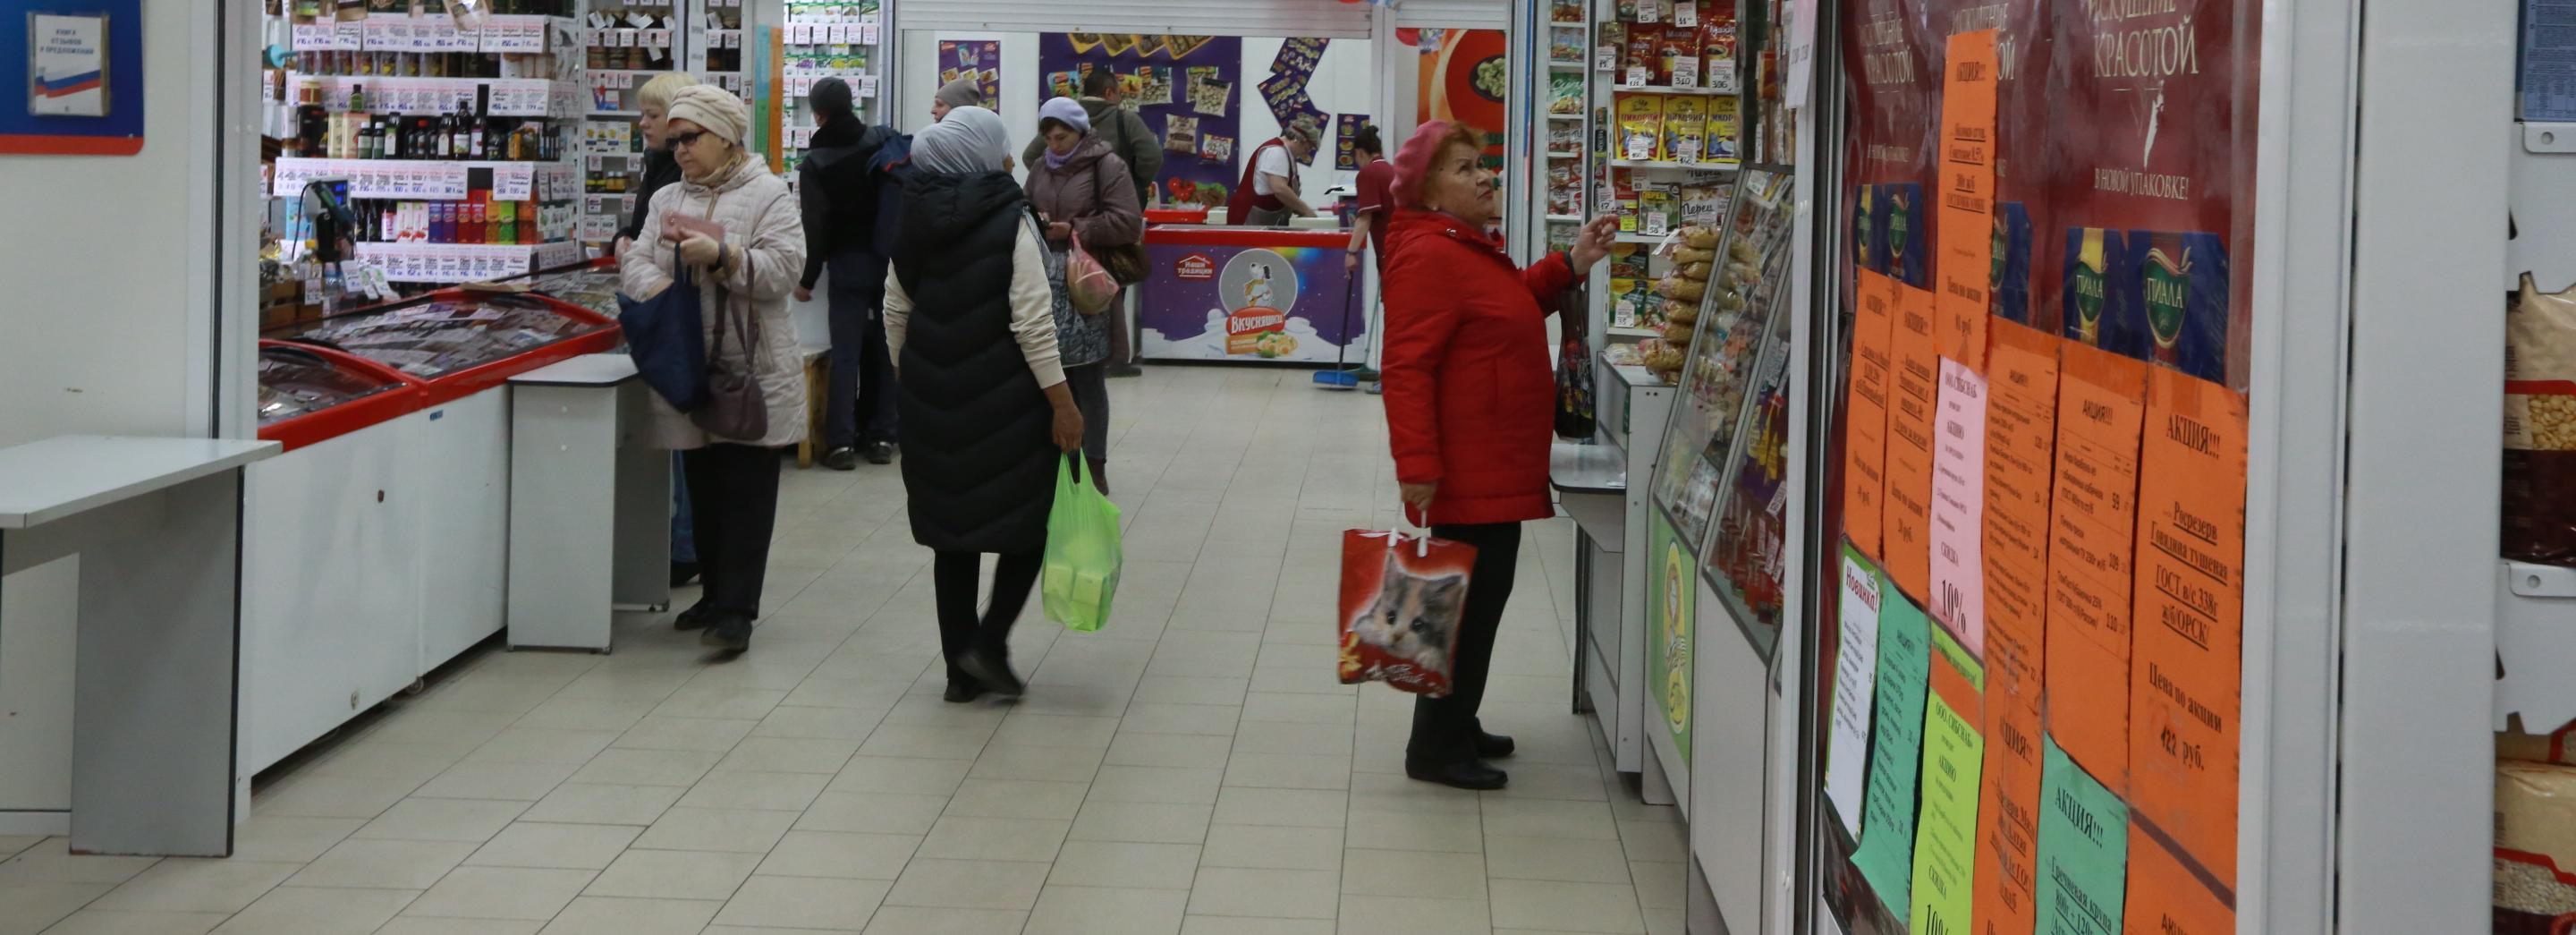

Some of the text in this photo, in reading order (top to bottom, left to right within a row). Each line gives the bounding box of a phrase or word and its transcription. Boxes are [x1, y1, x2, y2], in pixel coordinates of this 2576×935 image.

[2094, 14, 2199, 78] КРАСОТОЙ
[2095, 167, 2190, 200] В НОВОЙ УПАКОВКЕ!
[2076, 274, 2104, 299] ПИАЛА
[2148, 277, 2183, 309] ПИАЛА
[2166, 414, 2220, 460] АКЦИЯ!!!
[2174, 501, 2217, 540] Росрезерв
[2151, 521, 2228, 582] Говядина тушеная
[1845, 565, 1878, 614] Новинка!
[1942, 579, 1966, 633] 10%
[2156, 565, 2182, 597] ГОСТ
[2198, 587, 2218, 617] 338г
[2149, 661, 2222, 734] Цена по акции
[2182, 741, 2204, 771] руб.
[2055, 786, 2104, 849] АКЦИЯ!!!
[2052, 855, 2089, 908] Гречневая
[2089, 898, 2113, 933] крупа
